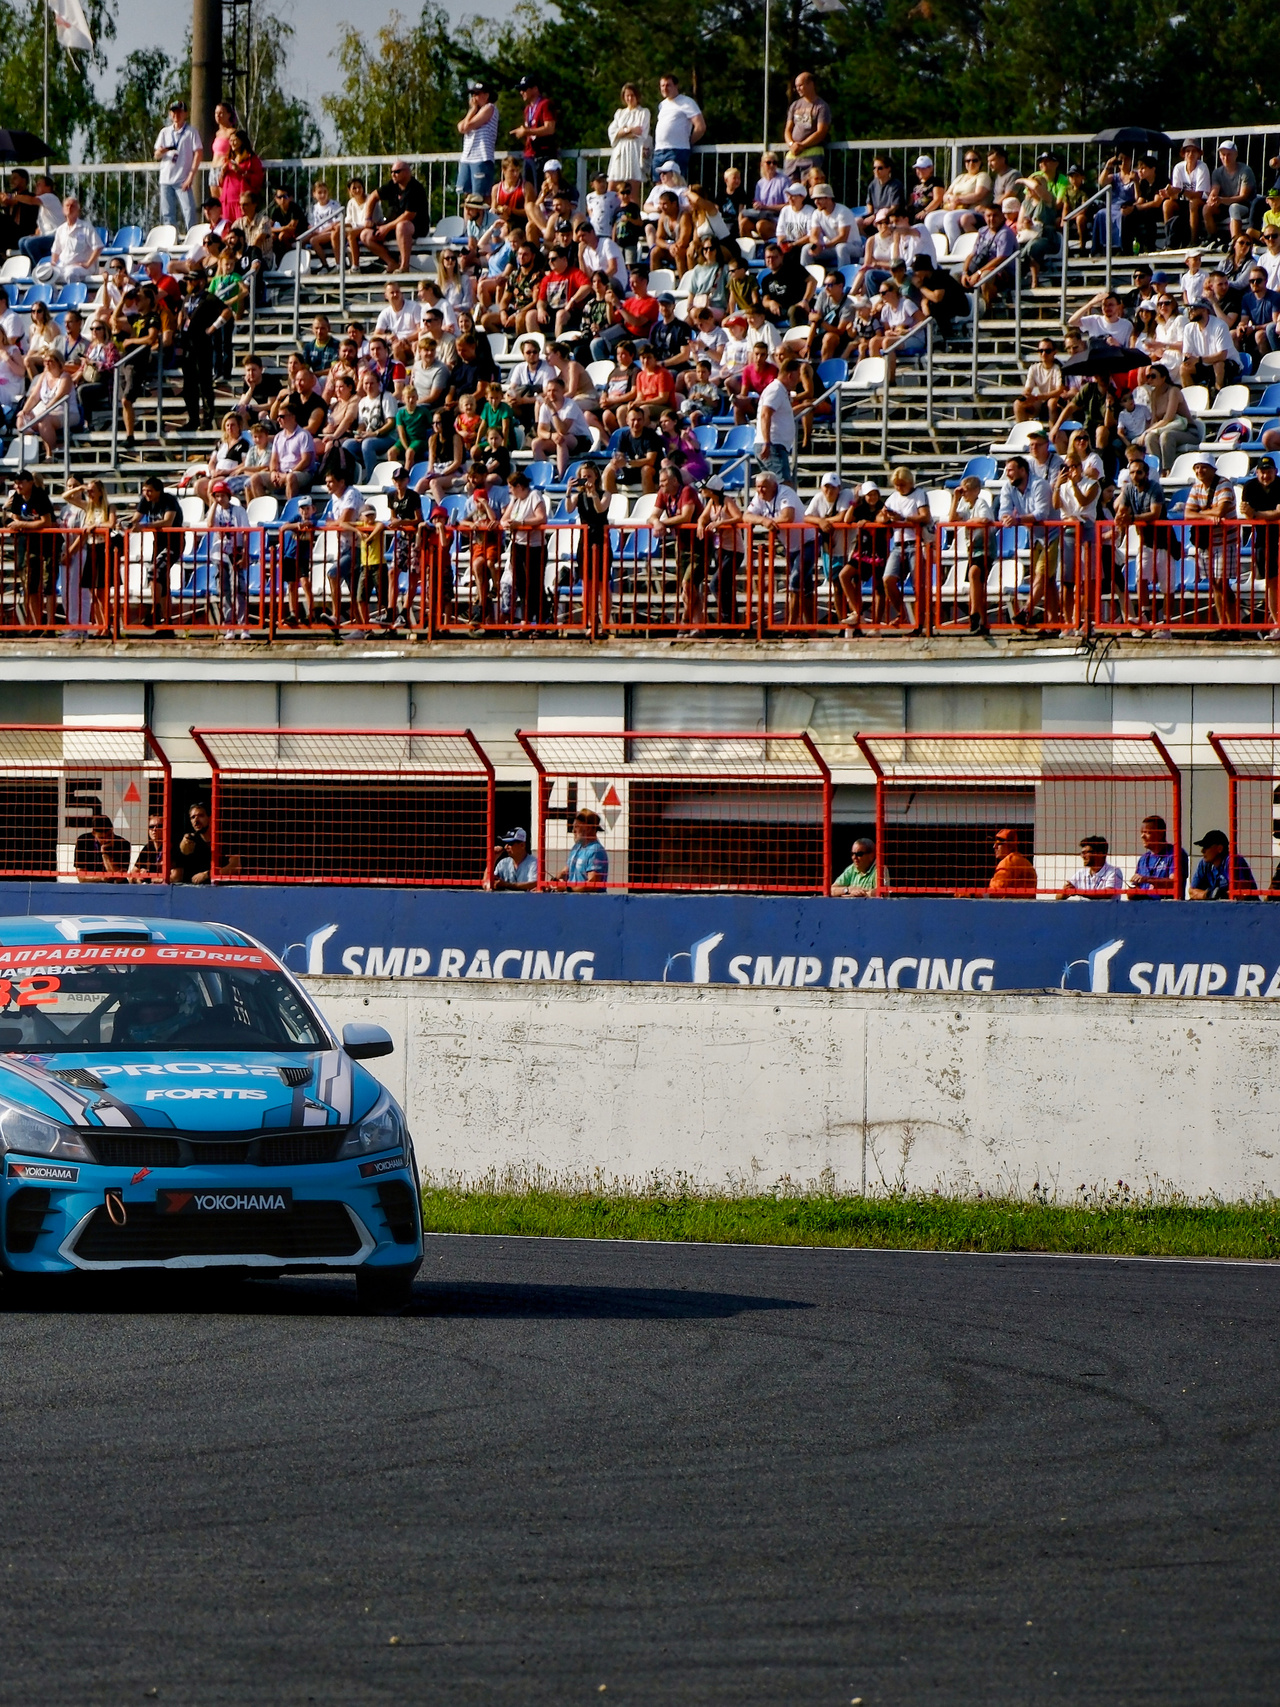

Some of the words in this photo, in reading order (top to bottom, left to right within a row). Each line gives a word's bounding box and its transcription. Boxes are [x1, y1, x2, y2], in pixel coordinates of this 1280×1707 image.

[65, 778, 102, 828] 5
[341, 946, 431, 976] SMP
[439, 948, 595, 981] RACING
[728, 955, 821, 986] SMP
[831, 956, 995, 991] RACING
[1130, 962, 1226, 996] SMP
[145, 1088, 267, 1101] FORTIS
[24, 1166, 72, 1179] YOKOHAMA
[373, 1157, 404, 1173] YOKOHAMA
[194, 1195, 285, 1211] YOKOHAMA
